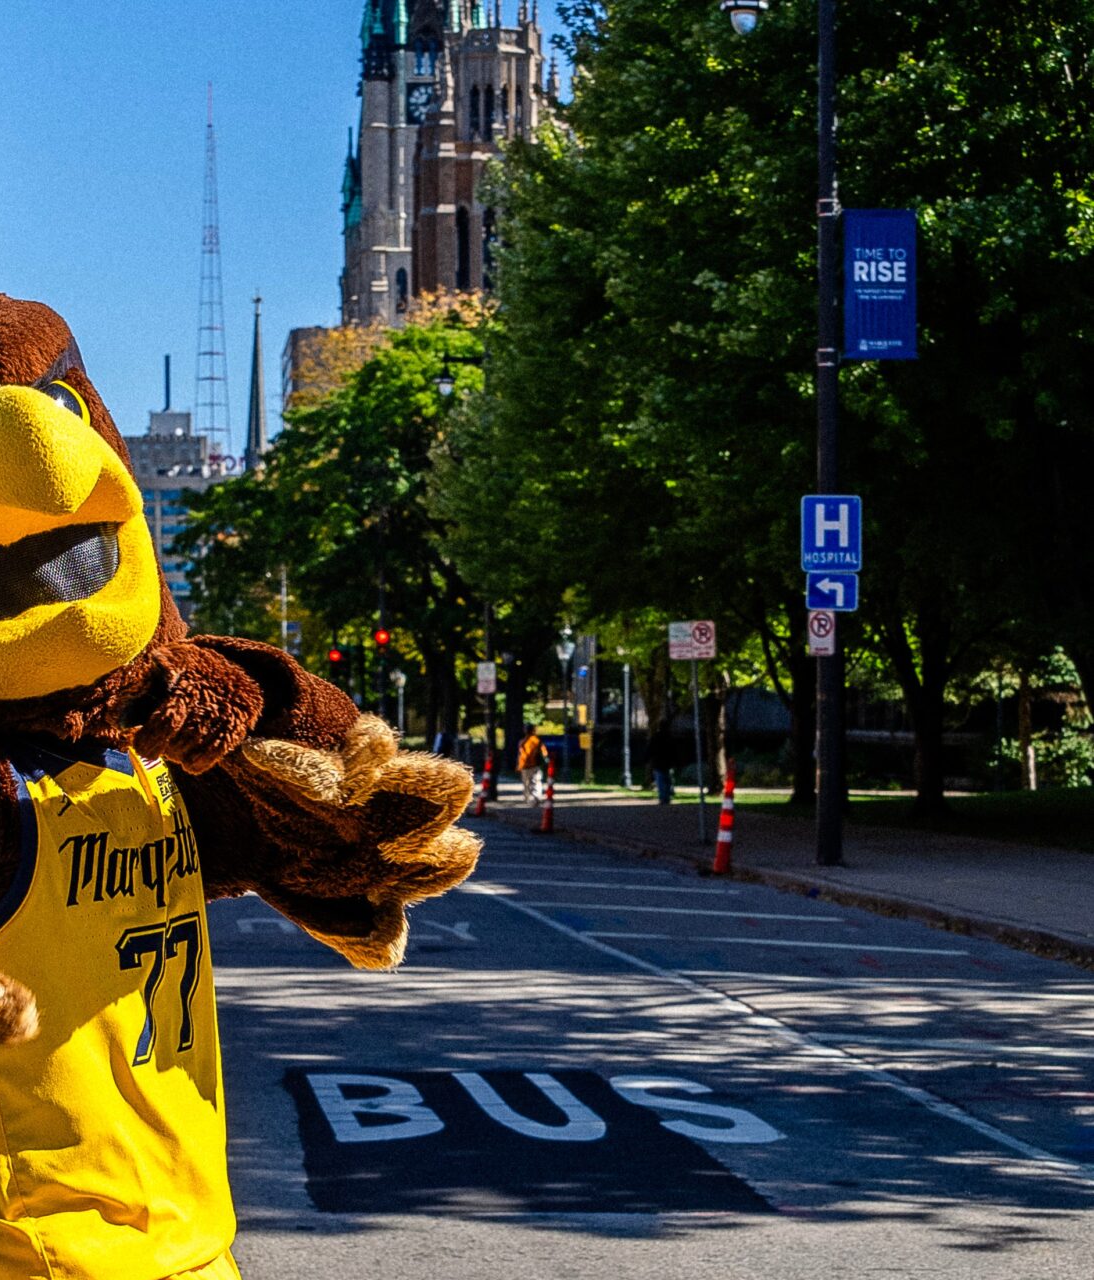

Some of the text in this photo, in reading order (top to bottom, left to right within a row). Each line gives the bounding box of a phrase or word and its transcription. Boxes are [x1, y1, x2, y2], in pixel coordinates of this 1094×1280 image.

[854, 261, 907, 282] RISE
[855, 248, 907, 260] TIME TO
[815, 503, 849, 548] H
[804, 552, 858, 564] HOSPITAL
[58, 806, 199, 908] Marqette
[115, 911, 203, 1067] 77
[307, 1072, 787, 1143] BUS
